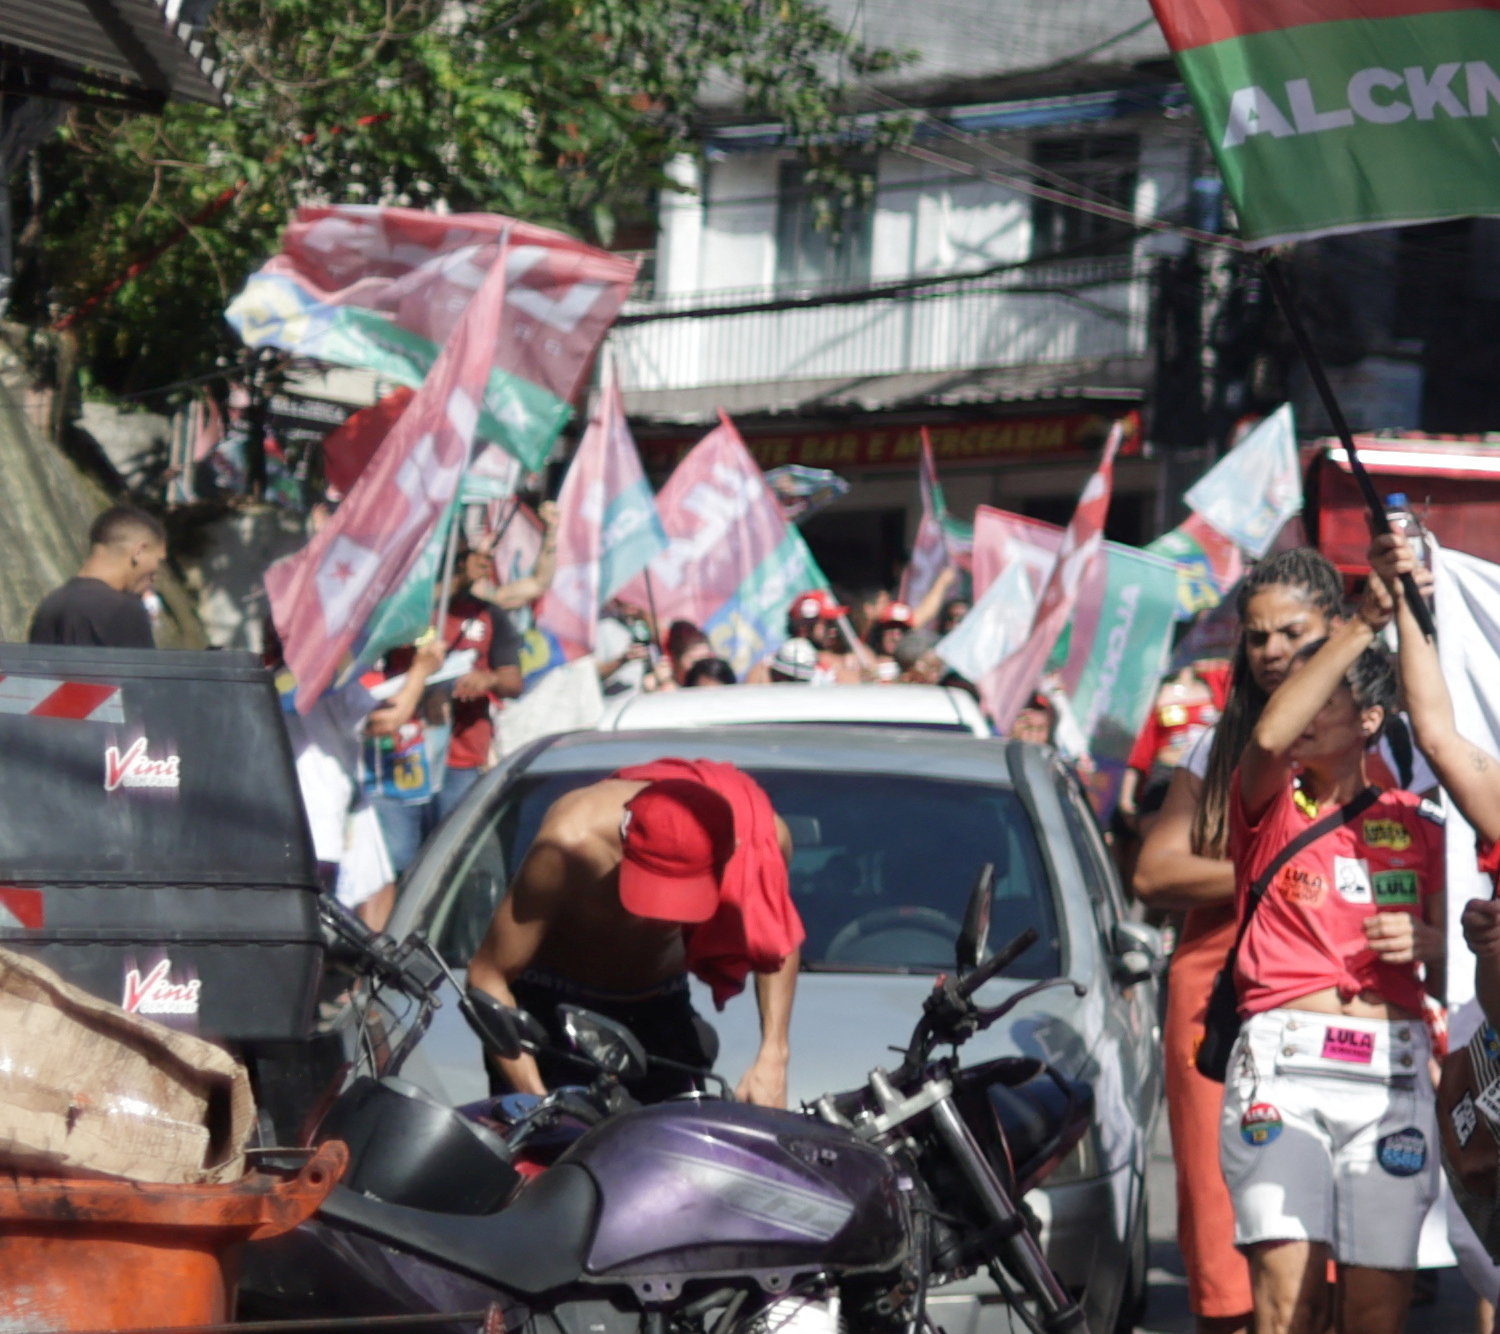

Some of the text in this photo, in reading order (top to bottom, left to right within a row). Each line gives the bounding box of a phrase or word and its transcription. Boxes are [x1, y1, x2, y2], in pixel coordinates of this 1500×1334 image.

[105, 737, 180, 790] Vini
[123, 959, 202, 1012] Vini
[1326, 1027, 1373, 1049] LULA
